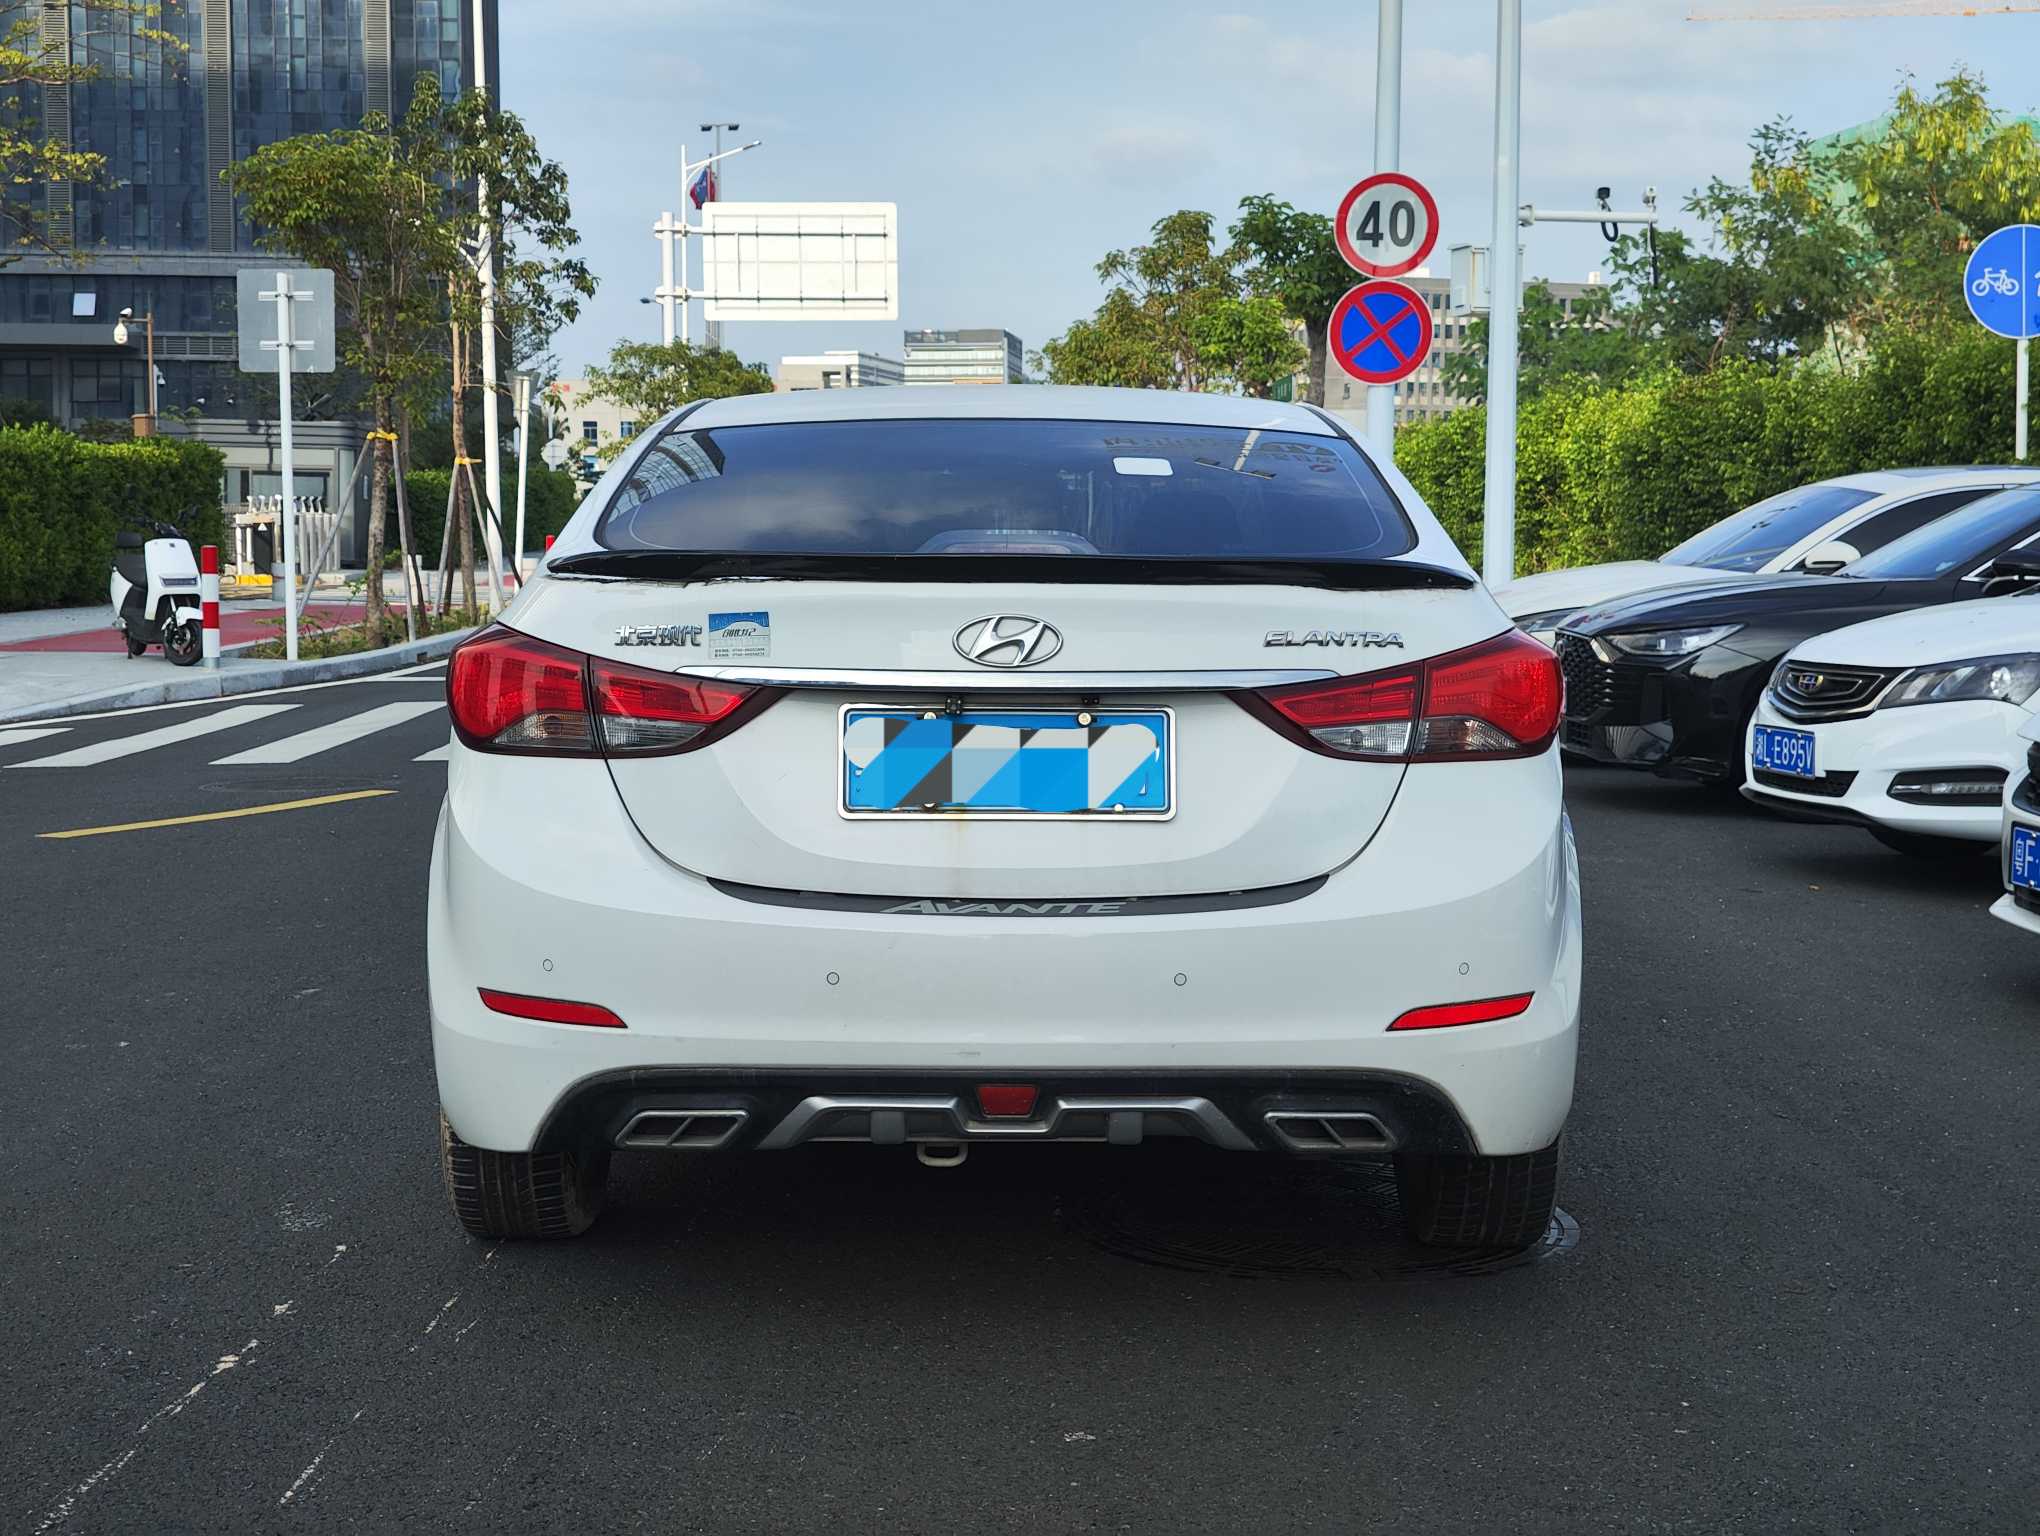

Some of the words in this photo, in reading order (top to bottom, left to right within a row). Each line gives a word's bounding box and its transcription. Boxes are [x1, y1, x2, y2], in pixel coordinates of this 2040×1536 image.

[1356, 200, 1415, 248] 40
[614, 624, 703, 647] 北京现代
[1263, 630, 1405, 649] ELANTRA
[880, 899, 1128, 914] AVANTE
